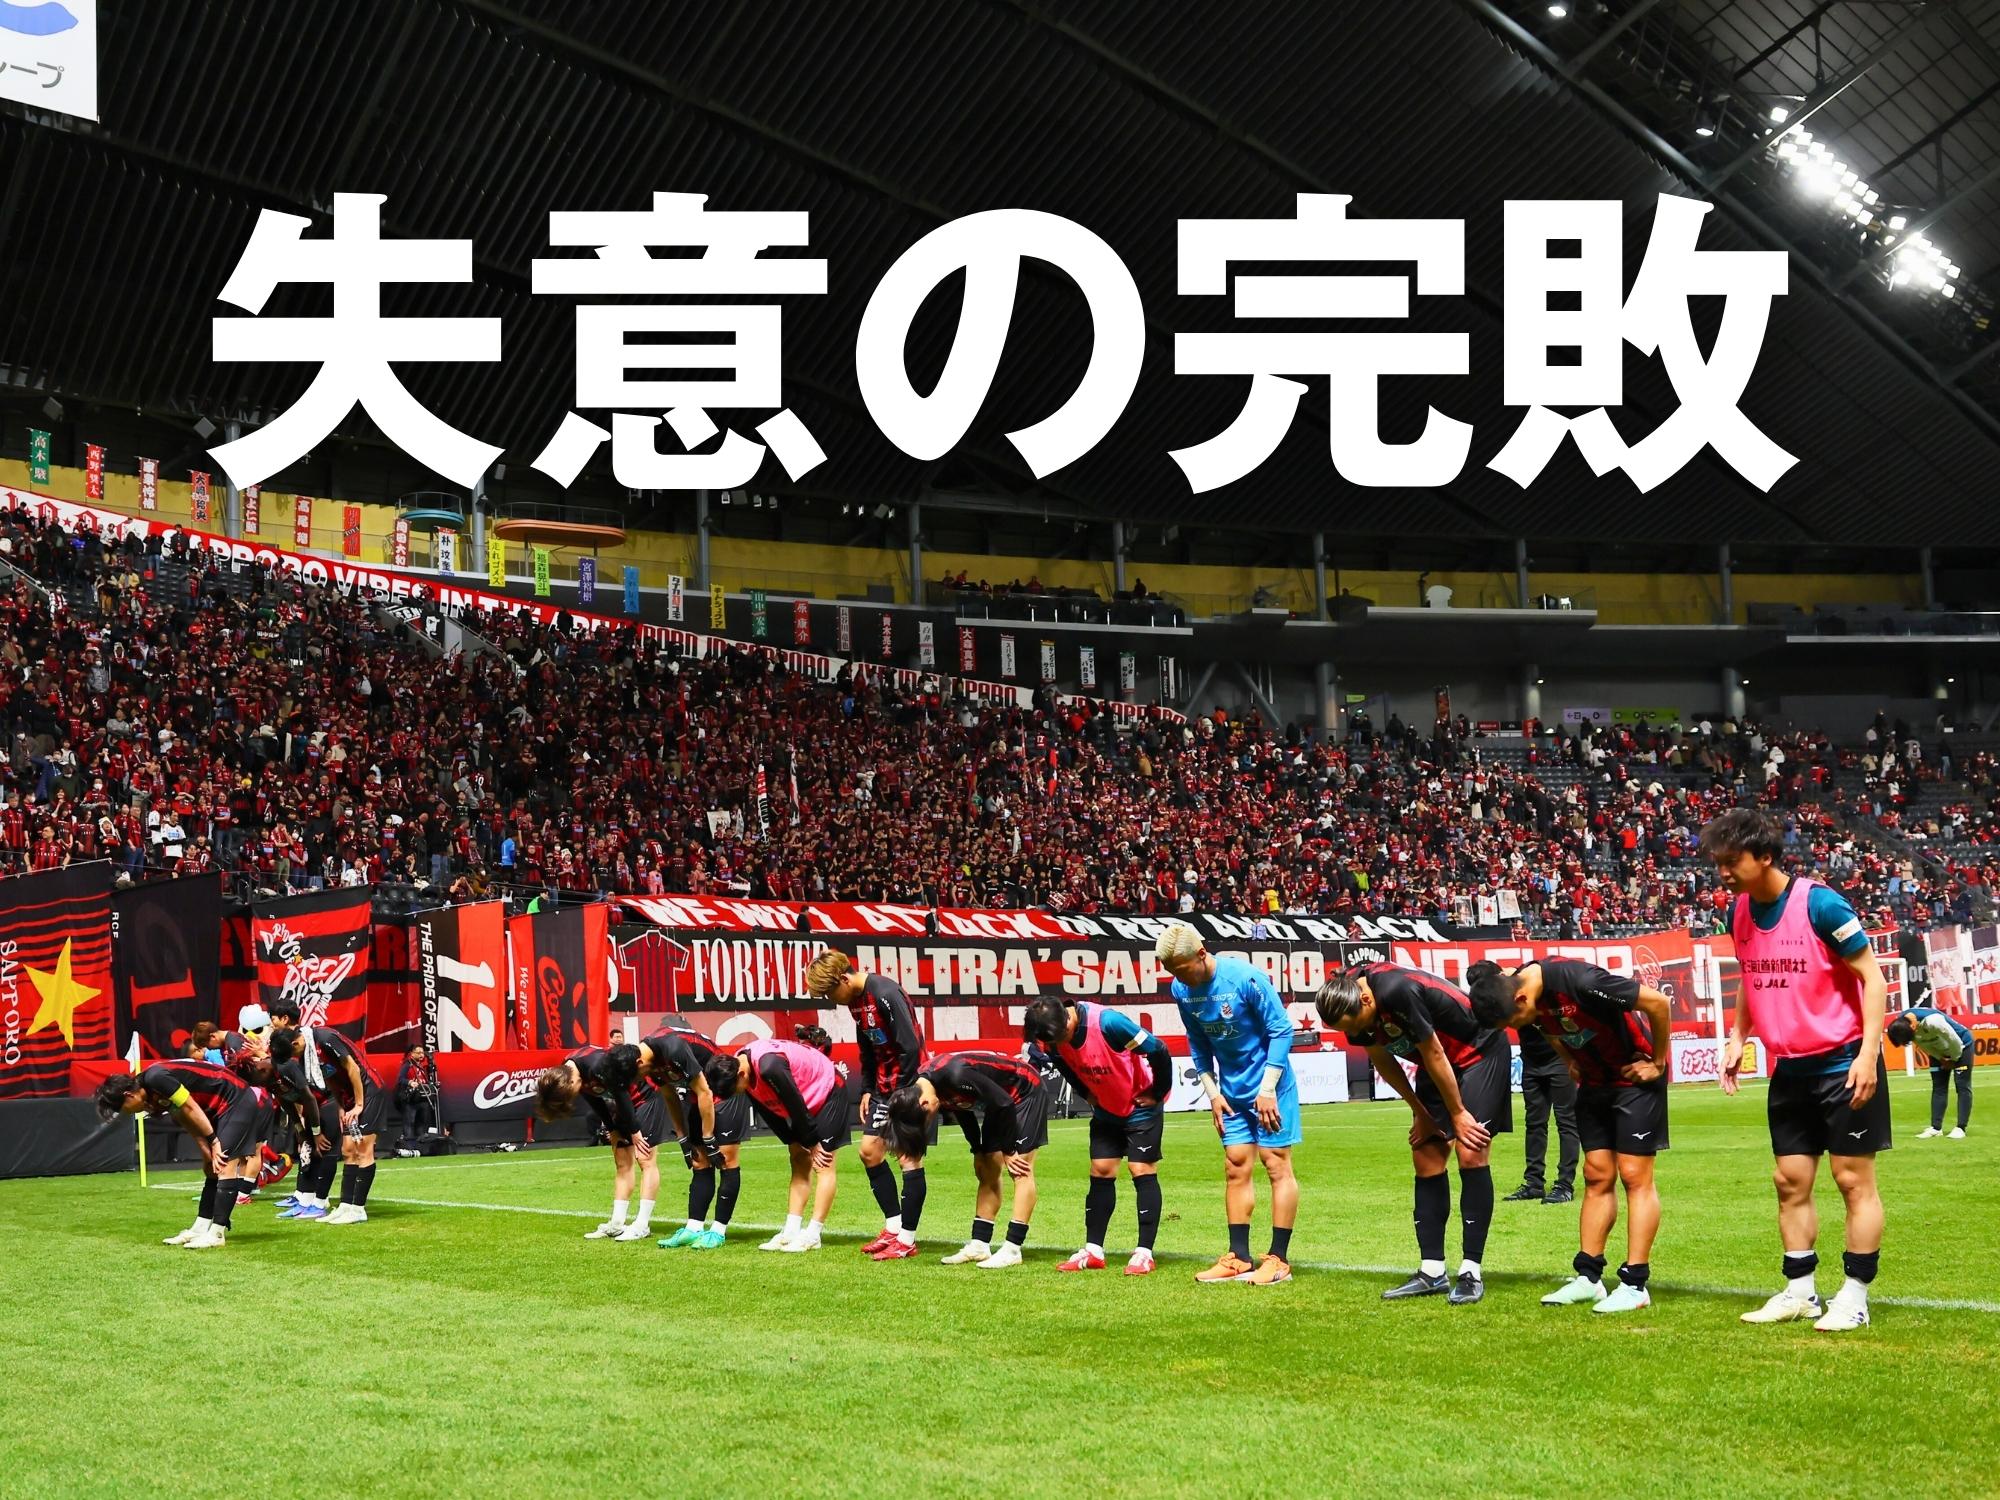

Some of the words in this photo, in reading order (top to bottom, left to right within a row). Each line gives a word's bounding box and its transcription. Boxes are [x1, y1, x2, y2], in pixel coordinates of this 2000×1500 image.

[440, 588, 472, 617] IN
[621, 898, 735, 927] WE
[420, 922, 432, 954] THE
[422, 954, 436, 997] PRIDE
[691, 937, 829, 1004] FOREVE
[1061, 949, 1325, 995] SAPRO
[1765, 978, 1790, 989] JAL
[424, 1000, 437, 1021] OF
[437, 955, 495, 1053] 12
